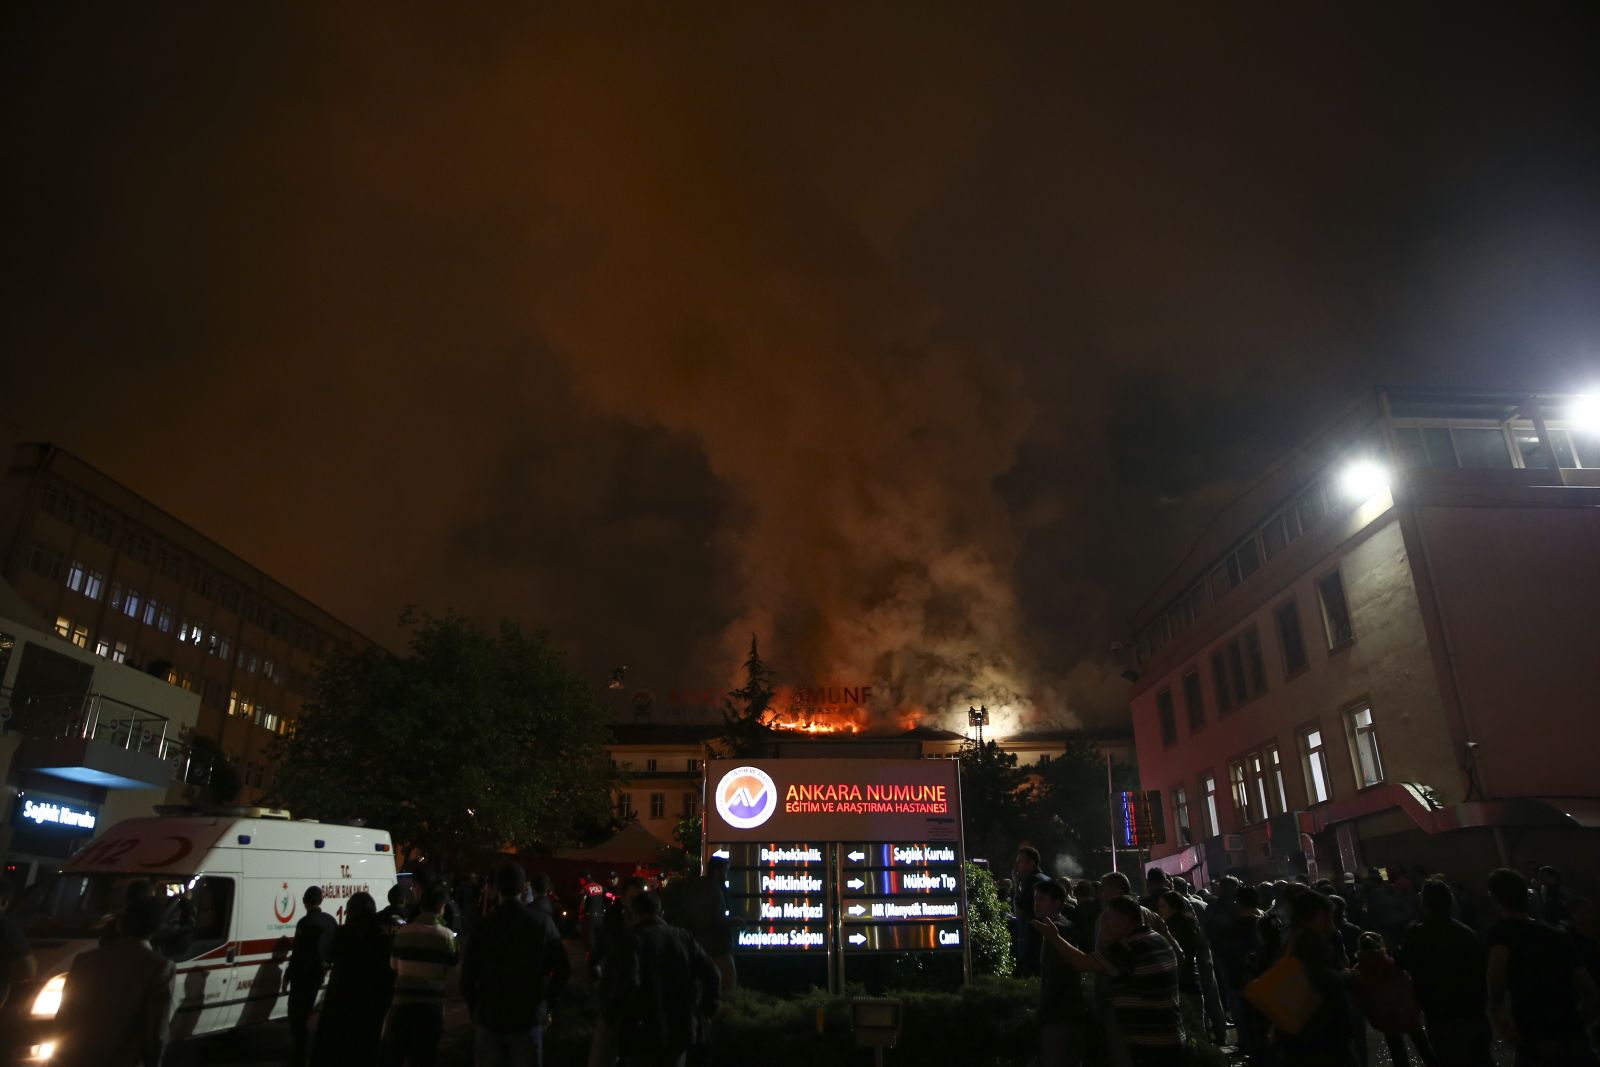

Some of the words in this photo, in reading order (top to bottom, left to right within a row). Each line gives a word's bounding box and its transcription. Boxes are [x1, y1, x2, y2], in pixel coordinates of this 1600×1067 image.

[786, 784, 862, 801] ANKARA
[867, 784, 947, 802] NUMUNE
[786, 800, 820, 813] EĞİTİM
[821, 802, 834, 813] VE
[836, 802, 893, 815] ARAŞTIRMA
[895, 801, 948, 814] HASTANESİ
[761, 847, 822, 864] Başhekimlik
[893, 847, 923, 864] Sağlık
[924, 846, 955, 861] Kurulu
[762, 875, 823, 891] Poliklinikler
[903, 873, 940, 890] Nükleer
[940, 873, 957, 892] Tıp
[762, 903, 783, 918] Kan
[784, 902, 824, 918] Merkezi
[871, 902, 885, 917] MR
[885, 902, 921, 920] (Manyetik
[922, 902, 958, 917] Rezonans)
[738, 930, 789, 947] Konferans
[789, 928, 824, 945] Salonu
[939, 929, 960, 945] Cami
